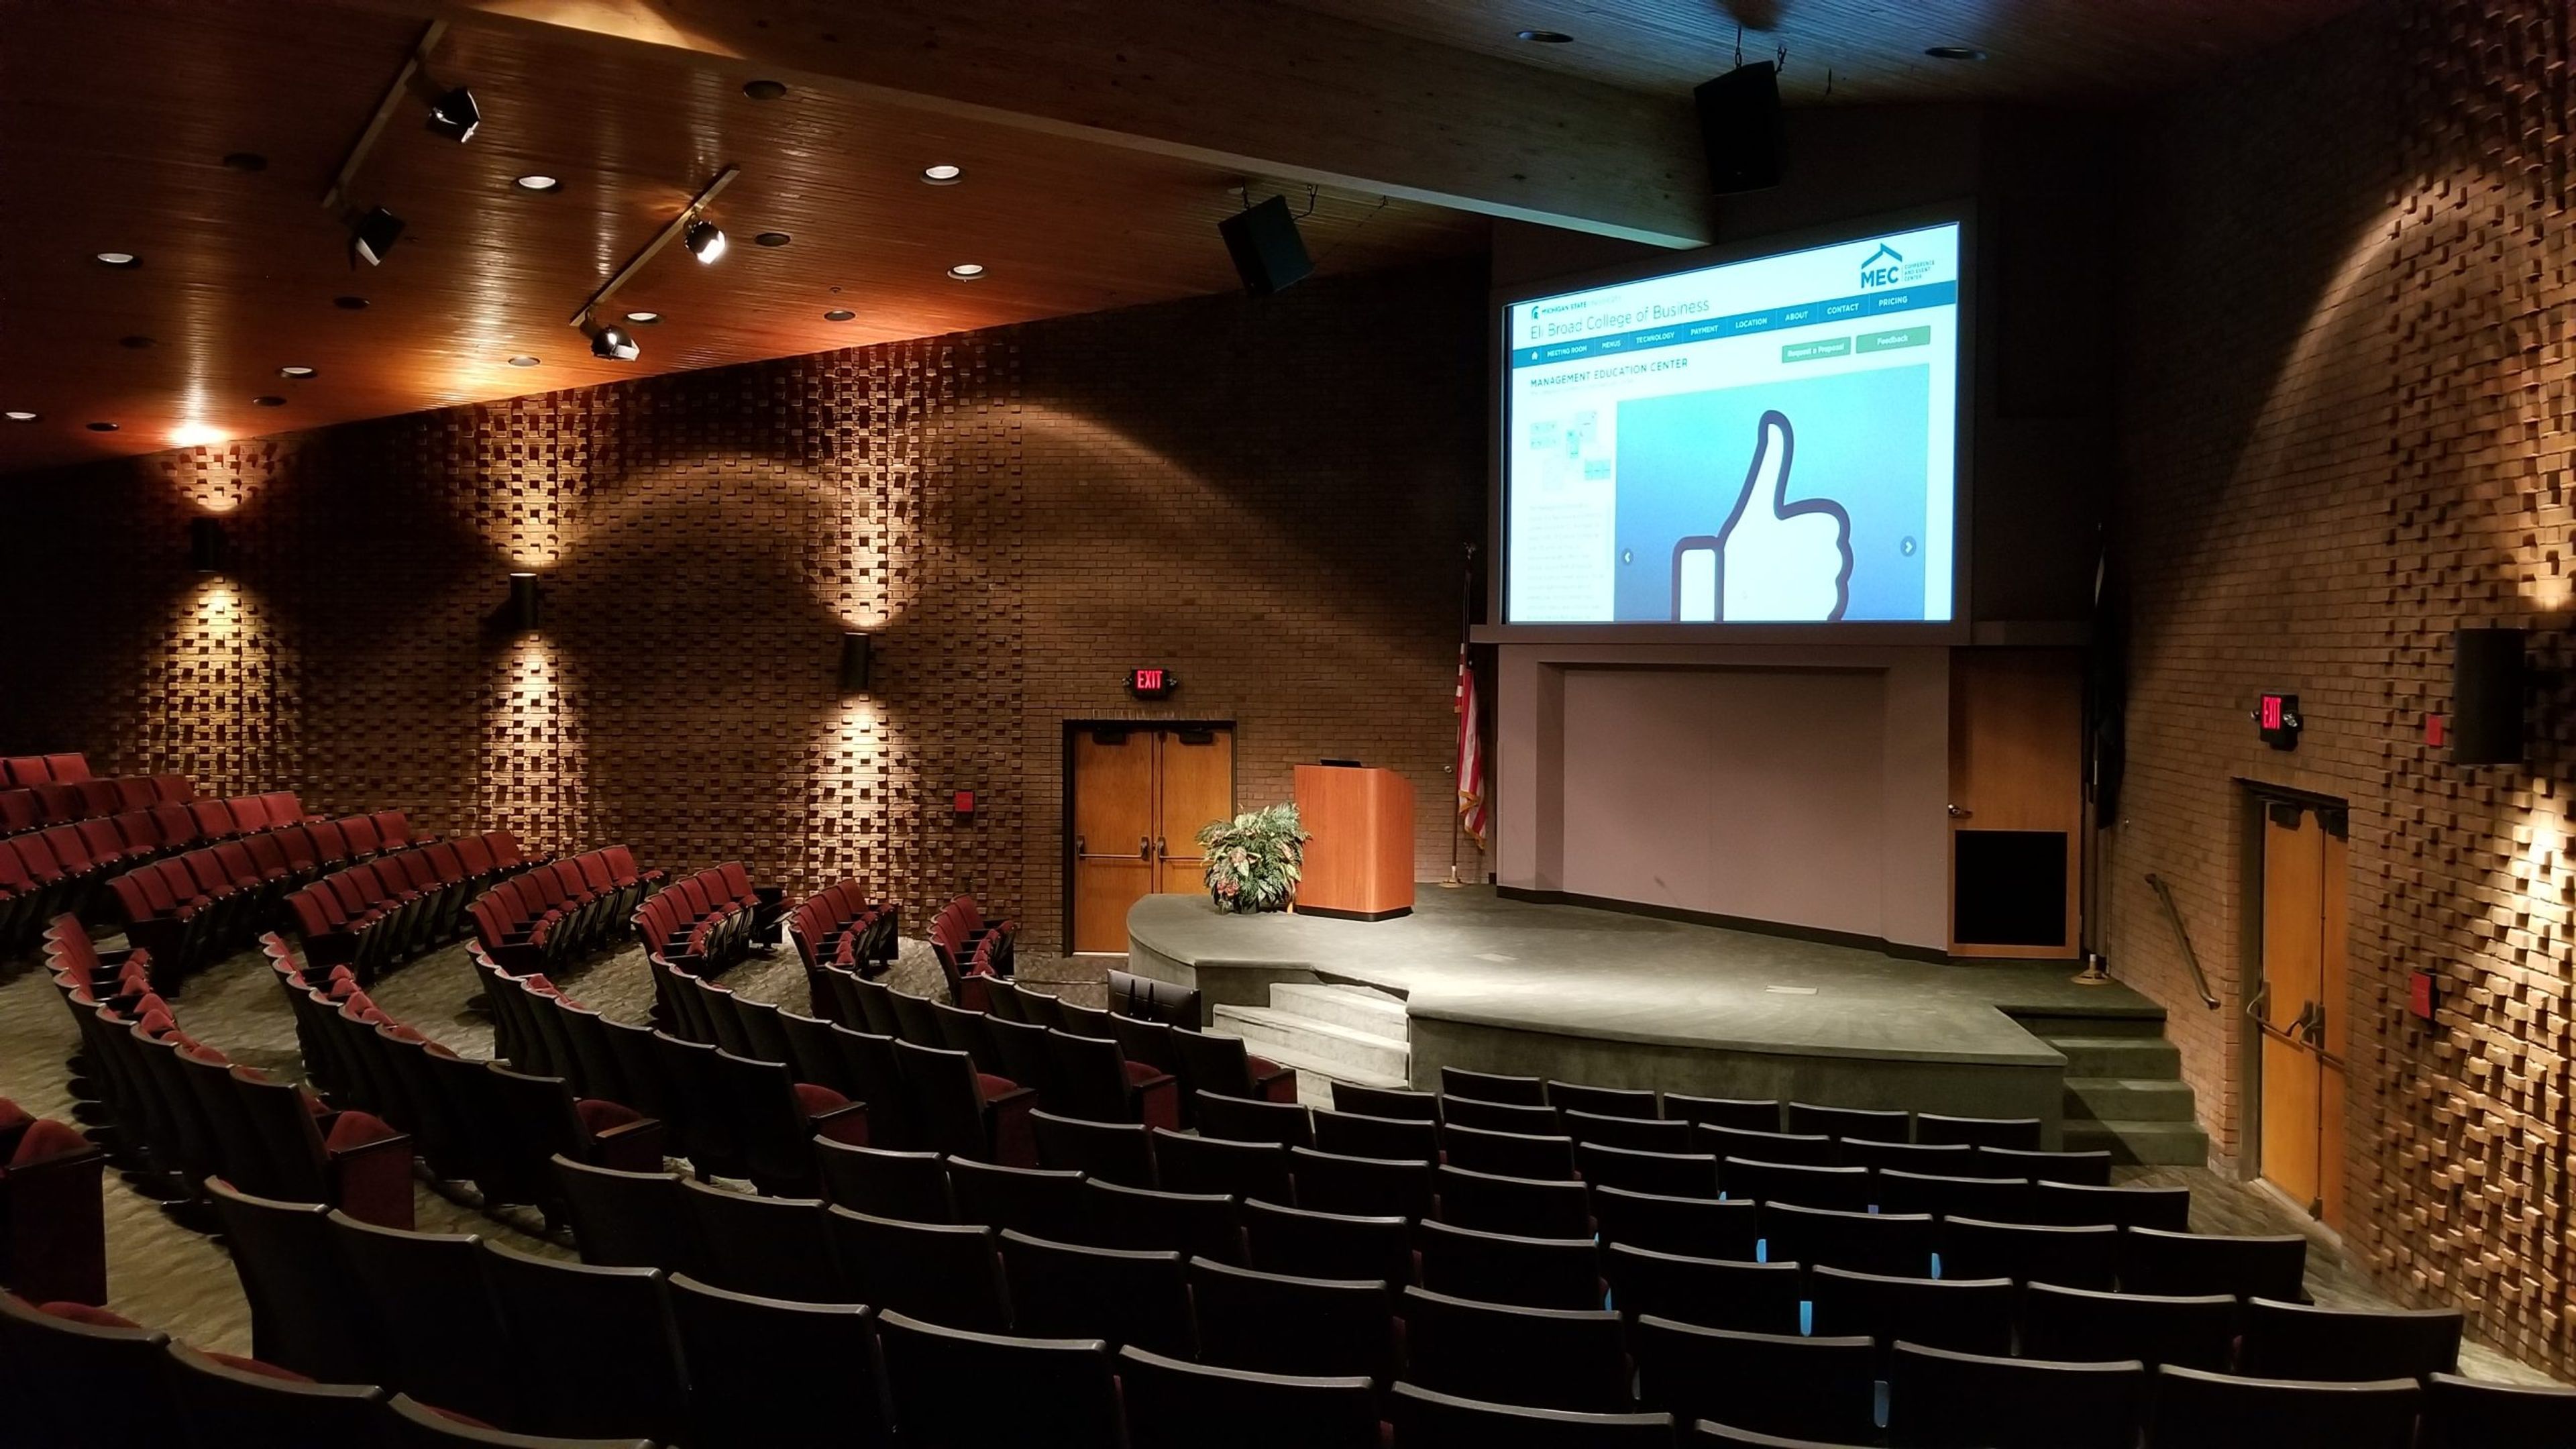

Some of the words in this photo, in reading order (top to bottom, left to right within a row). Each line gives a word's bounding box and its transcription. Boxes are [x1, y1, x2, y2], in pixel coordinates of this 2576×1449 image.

[1861, 266, 1899, 288] MEC
[1542, 305, 1569, 314] MICHIGAN
[1571, 301, 1587, 309] STATE
[1878, 296, 1908, 307] PRICING
[1827, 303, 1859, 315] CONTACT
[1548, 318, 1582, 336] Broad
[1587, 313, 1631, 330] College
[1636, 306, 1649, 322] of
[1653, 300, 1709, 320] Business
[1785, 311, 1809, 322] ABOUT
[1735, 317, 1768, 329] LOCATION
[1690, 325, 1719, 335] PAYMENT
[1636, 331, 1675, 343] TECHNOLOGY
[1877, 335, 1909, 345] Feedback
[1602, 340, 1621, 349] MENUS
[1547, 347, 1570, 357] MEETING
[1571, 345, 1587, 353] ROOM
[1531, 371, 1591, 387] MANAGEMENT
[1594, 363, 1647, 379] EDUCATION
[1650, 358, 1688, 371] CENTER
[1137, 670, 1163, 689] EXIT
[2263, 696, 2282, 730] EXIT
